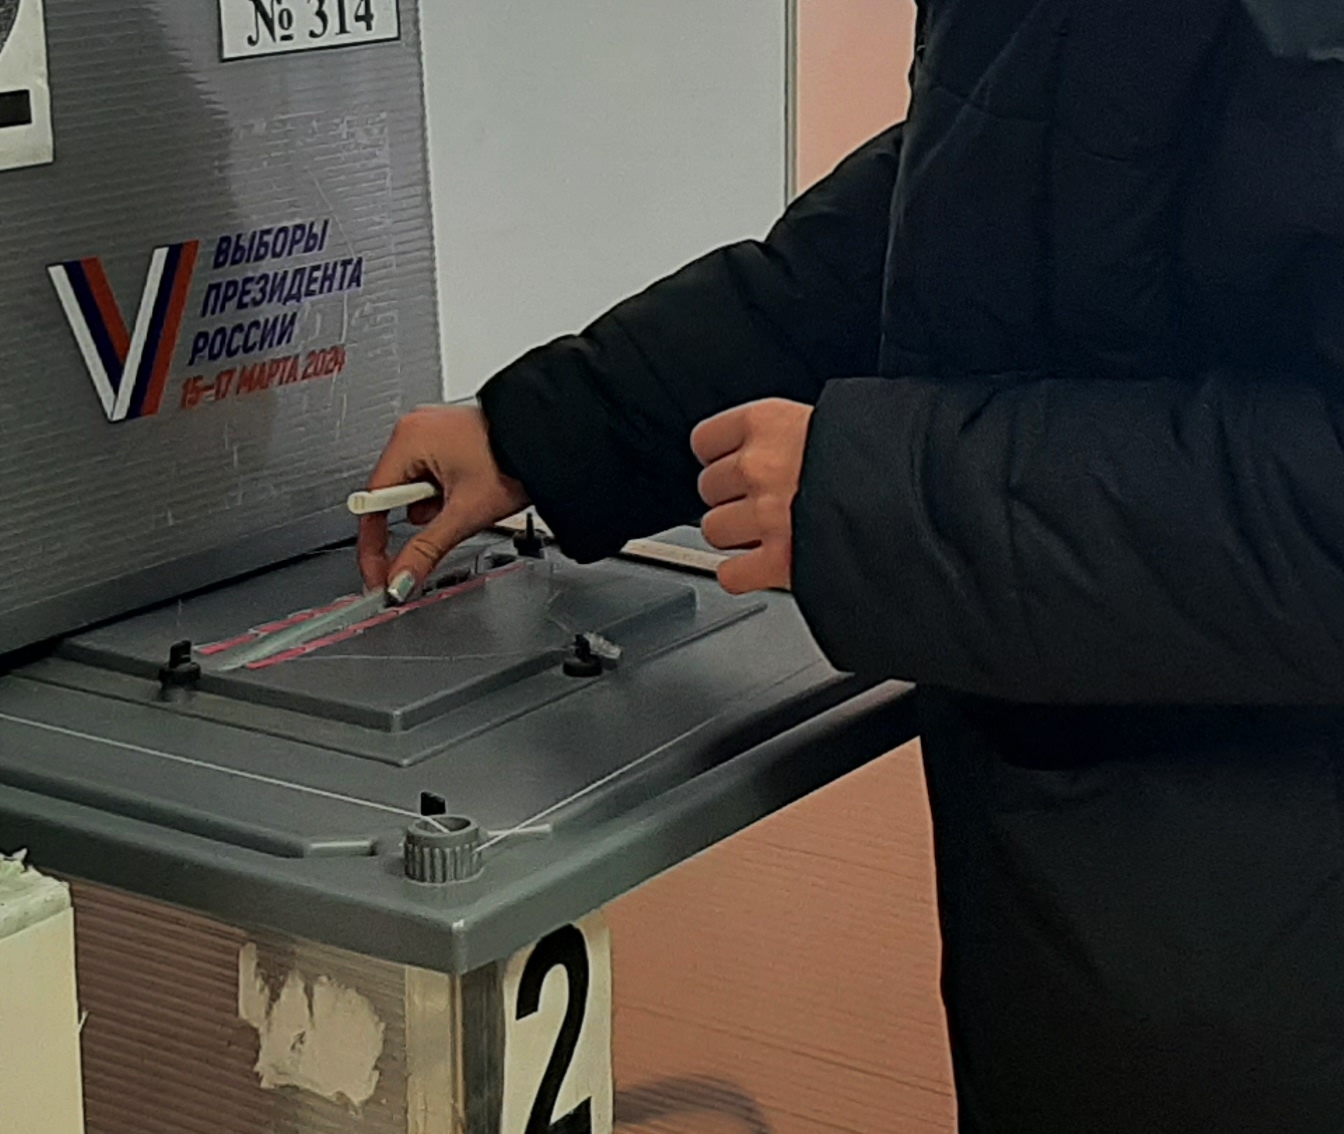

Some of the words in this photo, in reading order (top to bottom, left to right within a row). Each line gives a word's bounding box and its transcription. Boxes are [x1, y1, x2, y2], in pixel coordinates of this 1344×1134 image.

[213, 218, 331, 270] ВЫБОРЫ
[202, 256, 364, 318] ПРЕЗИДЕНТА
[188, 311, 298, 366] РОССИИ
[236, 354, 303, 396] МАРТА
[516, 922, 593, 1134] 2
